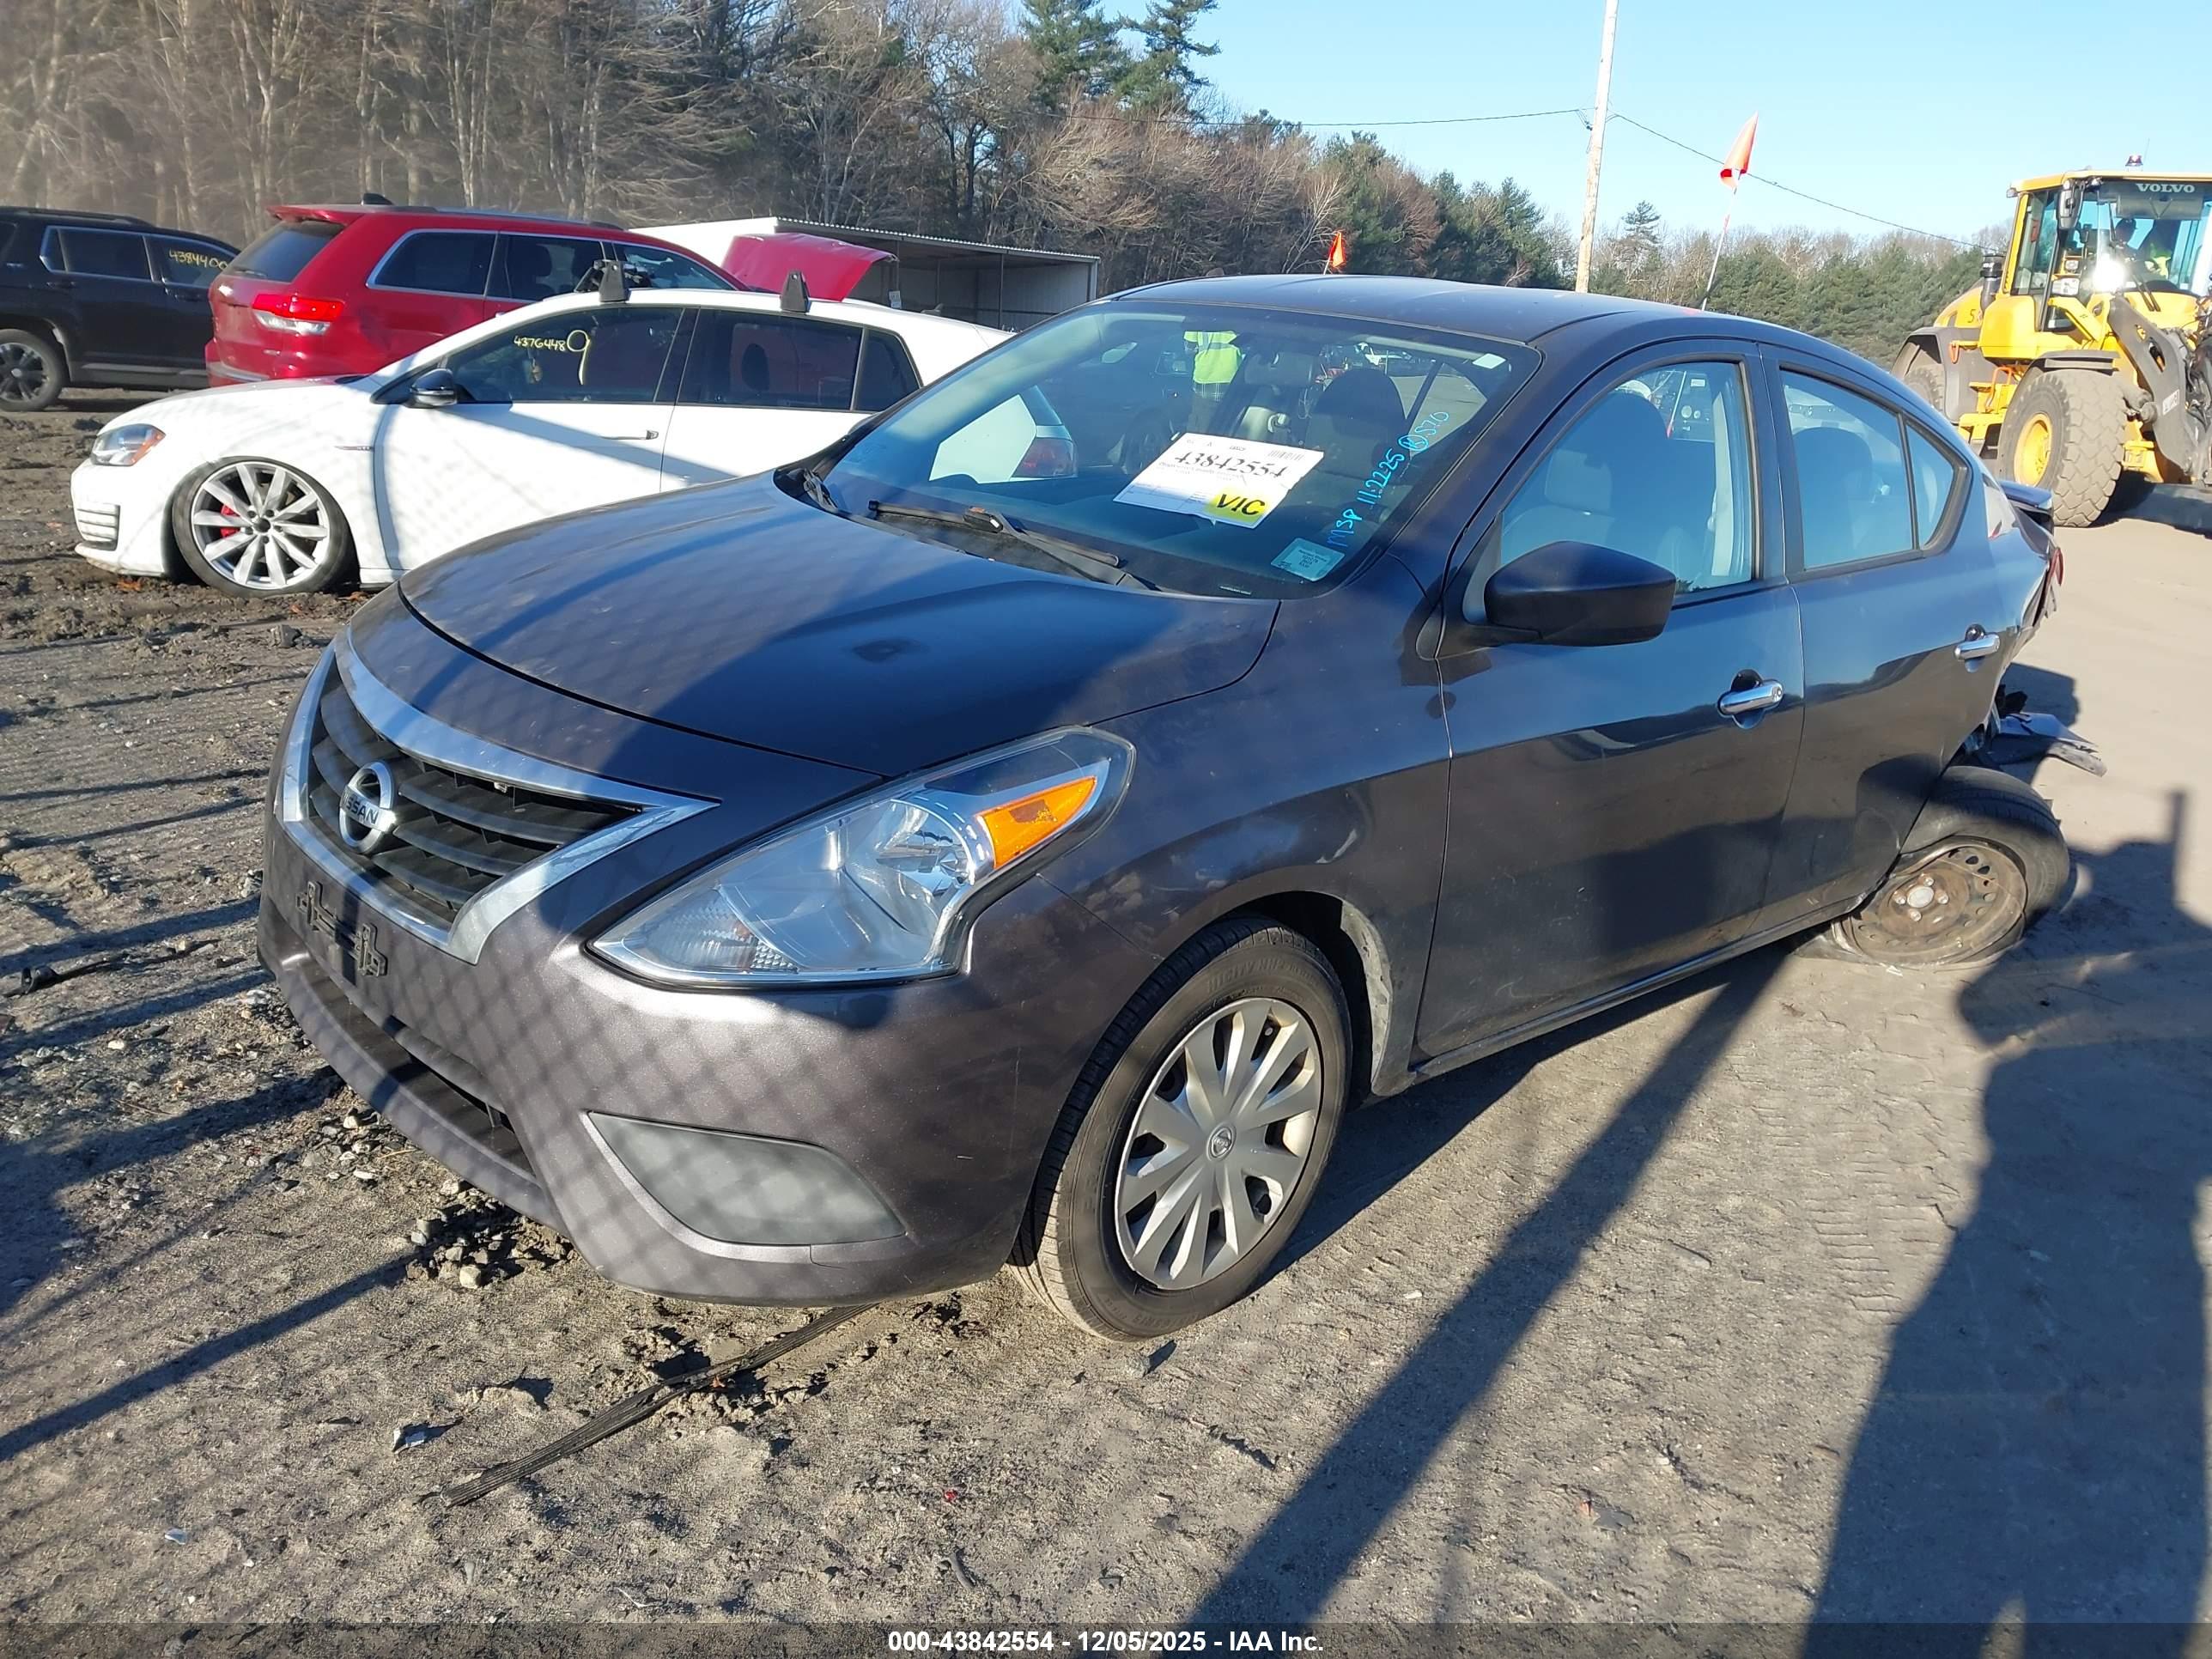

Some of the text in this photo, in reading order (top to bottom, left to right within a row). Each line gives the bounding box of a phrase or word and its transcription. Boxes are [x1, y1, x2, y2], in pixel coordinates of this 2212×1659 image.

[2136, 183, 2196, 193] VOLVO
[514, 329, 590, 386] 43764489
[1174, 452, 1288, 477] 43842554
[1217, 493, 1266, 515] VIC
